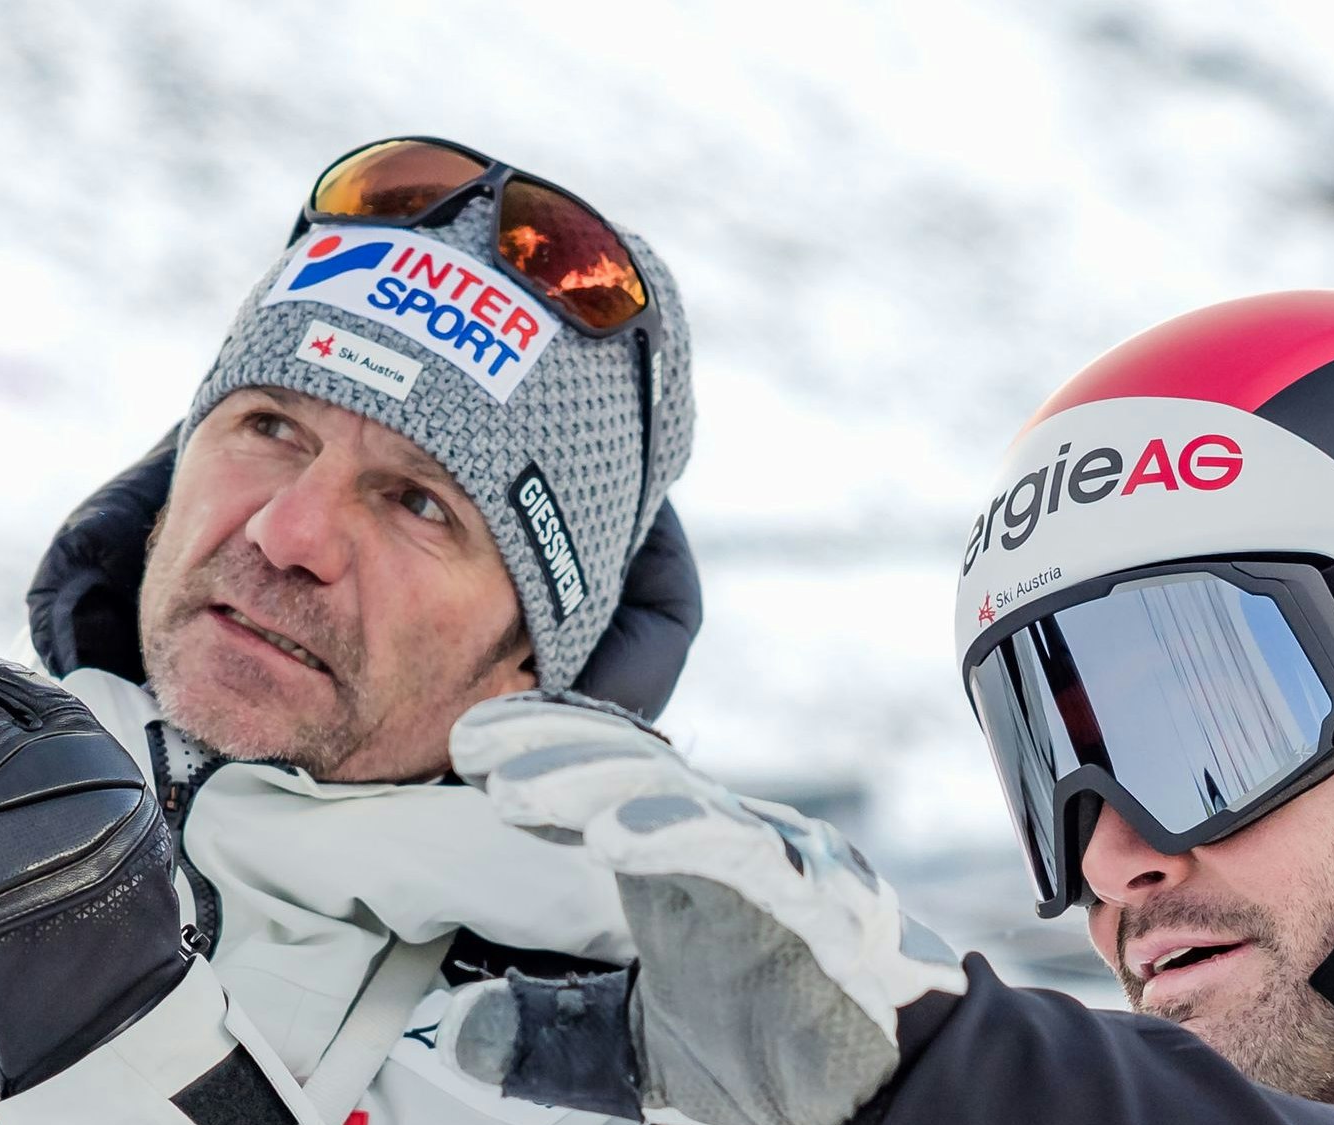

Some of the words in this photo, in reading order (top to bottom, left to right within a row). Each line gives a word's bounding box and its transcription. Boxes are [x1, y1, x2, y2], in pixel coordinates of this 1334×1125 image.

[367, 277, 520, 377] SPORT
[391, 247, 539, 351] INTER
[338, 347, 359, 363] Ski
[360, 357, 405, 383] Austria
[519, 477, 585, 616] GIESSWEIN
[995, 586, 1014, 609] Ski
[1016, 566, 1063, 599] Austria
